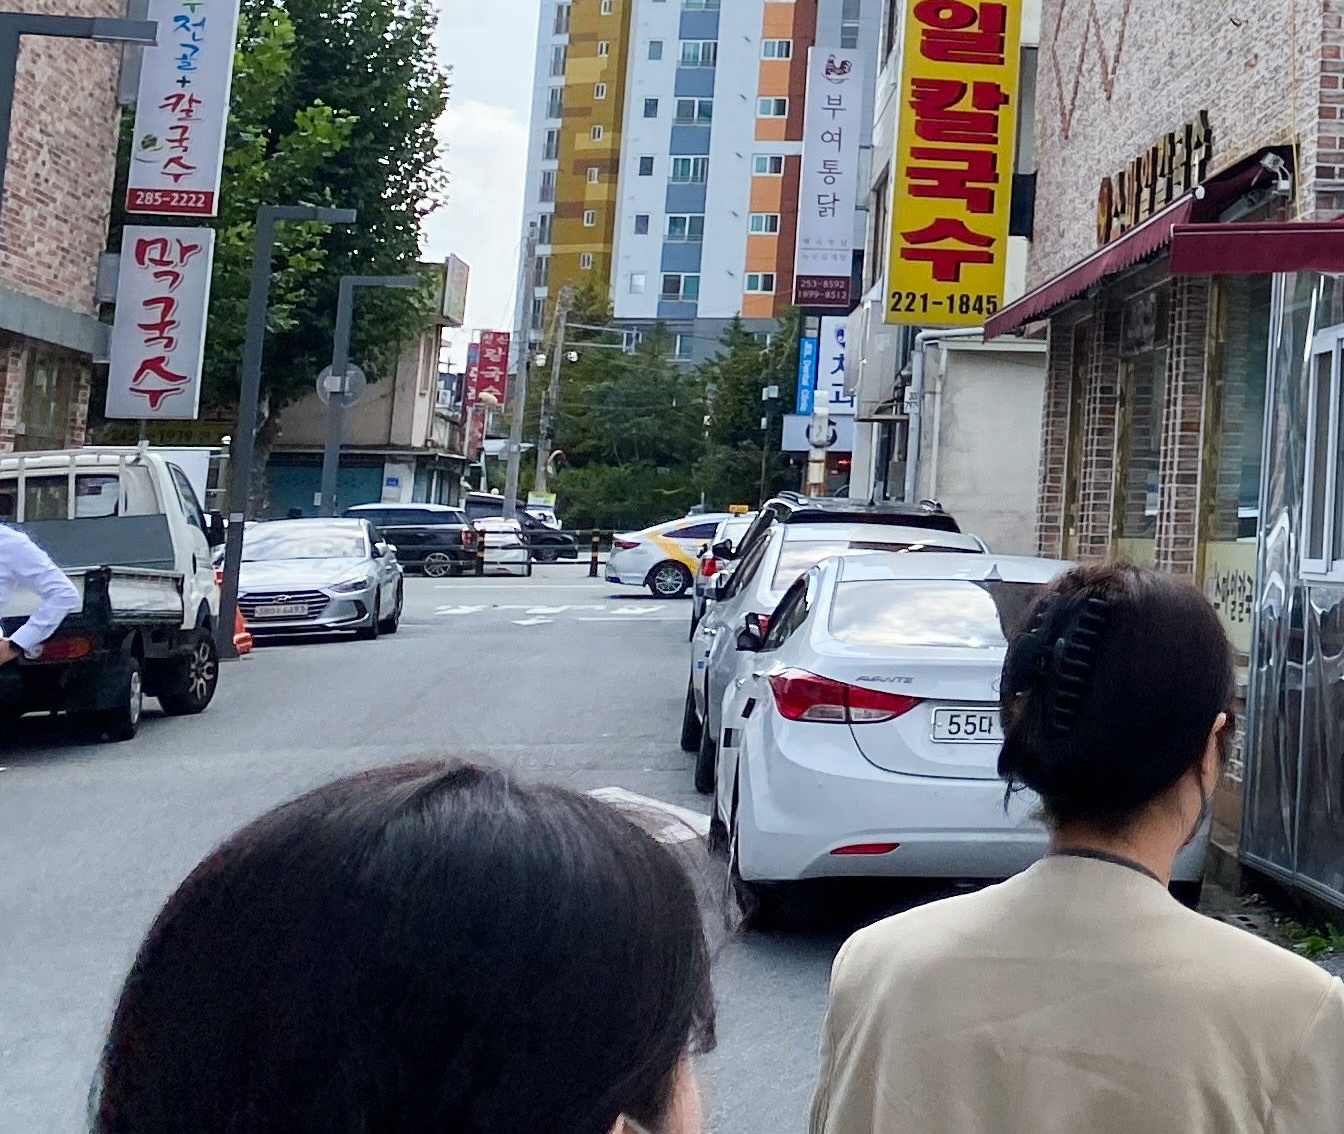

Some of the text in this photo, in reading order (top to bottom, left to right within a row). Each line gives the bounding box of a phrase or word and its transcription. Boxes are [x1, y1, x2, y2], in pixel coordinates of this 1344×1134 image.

[817, 94, 847, 218] 부여통닭
[135, 191, 205, 207] 285-2222
[129, 237, 201, 409] 막국수
[890, 291, 997, 315] 221-1845
[1213, 568, 1254, 624] 스마일칼국
[947, 713, 993, 735] 55다
